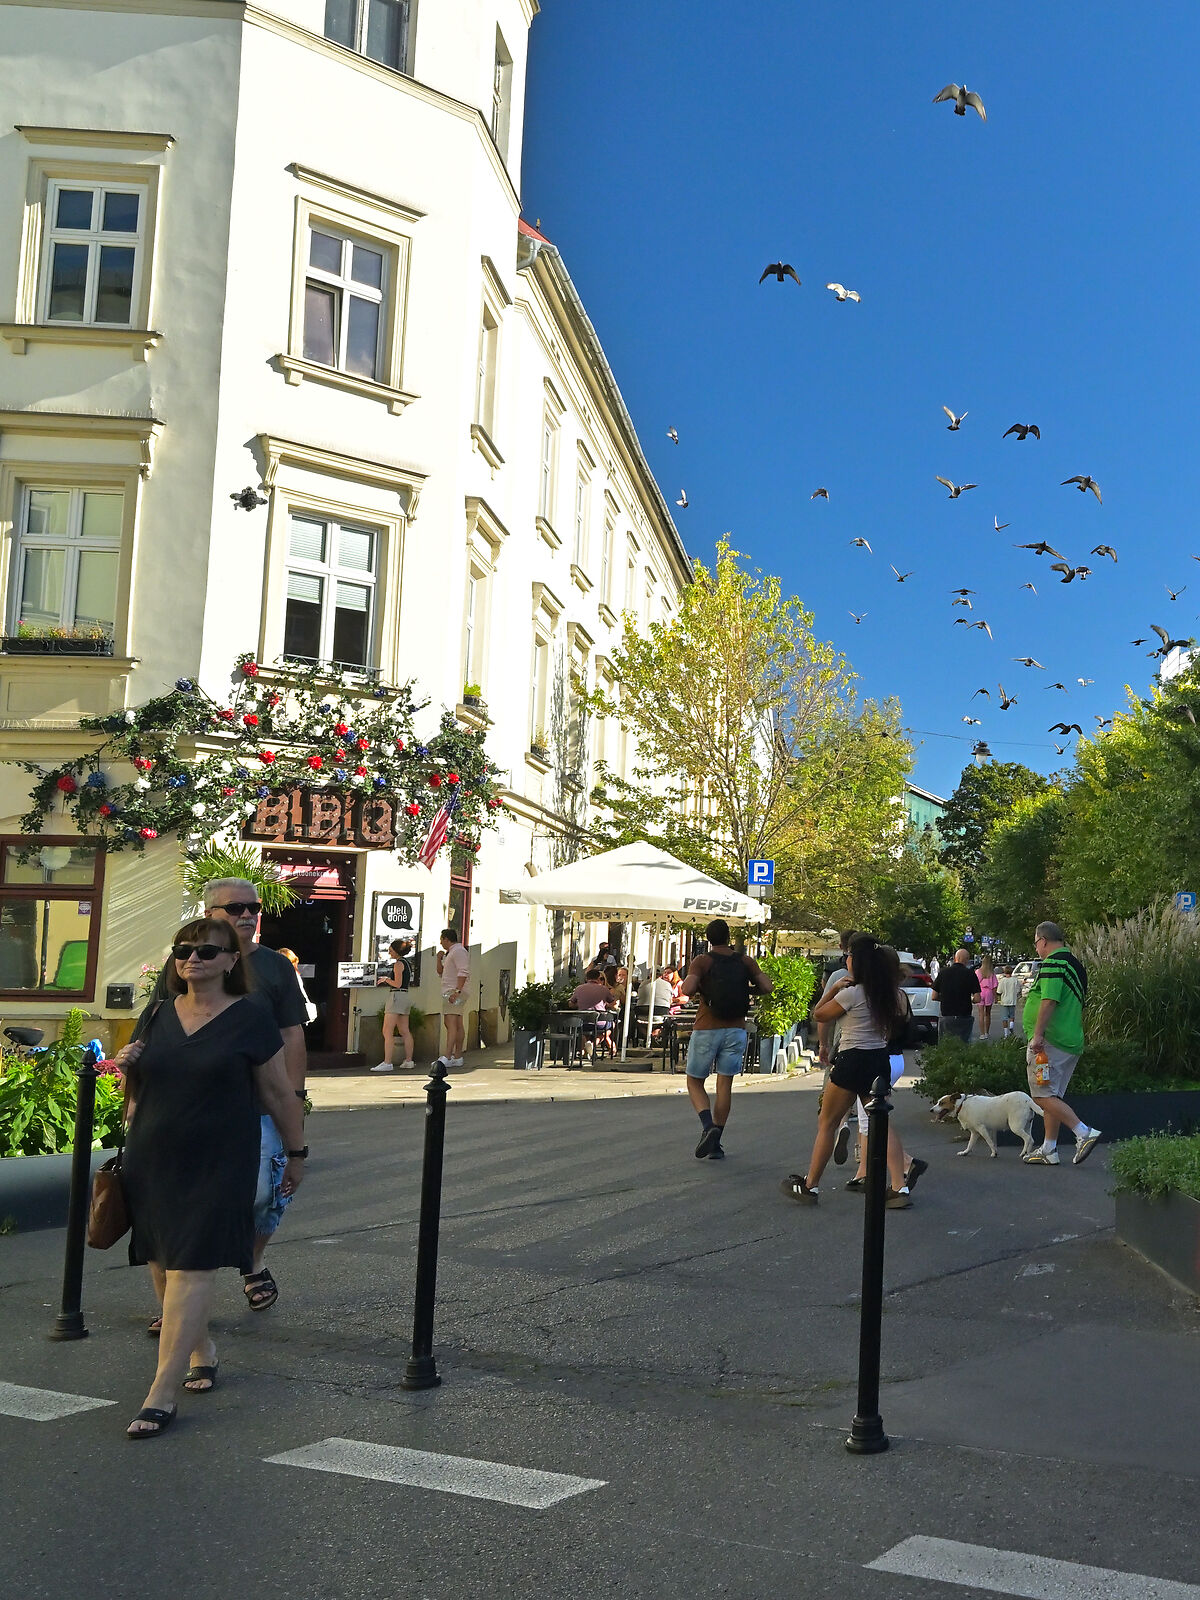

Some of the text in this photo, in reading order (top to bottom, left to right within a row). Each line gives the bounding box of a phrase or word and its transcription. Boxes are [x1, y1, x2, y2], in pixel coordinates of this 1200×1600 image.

[753, 862, 769, 882] P
[683, 897, 738, 913] PEPSI
[1180, 894, 1192, 909] P
[387, 905, 407, 915] Well
[387, 914, 407, 923] done
